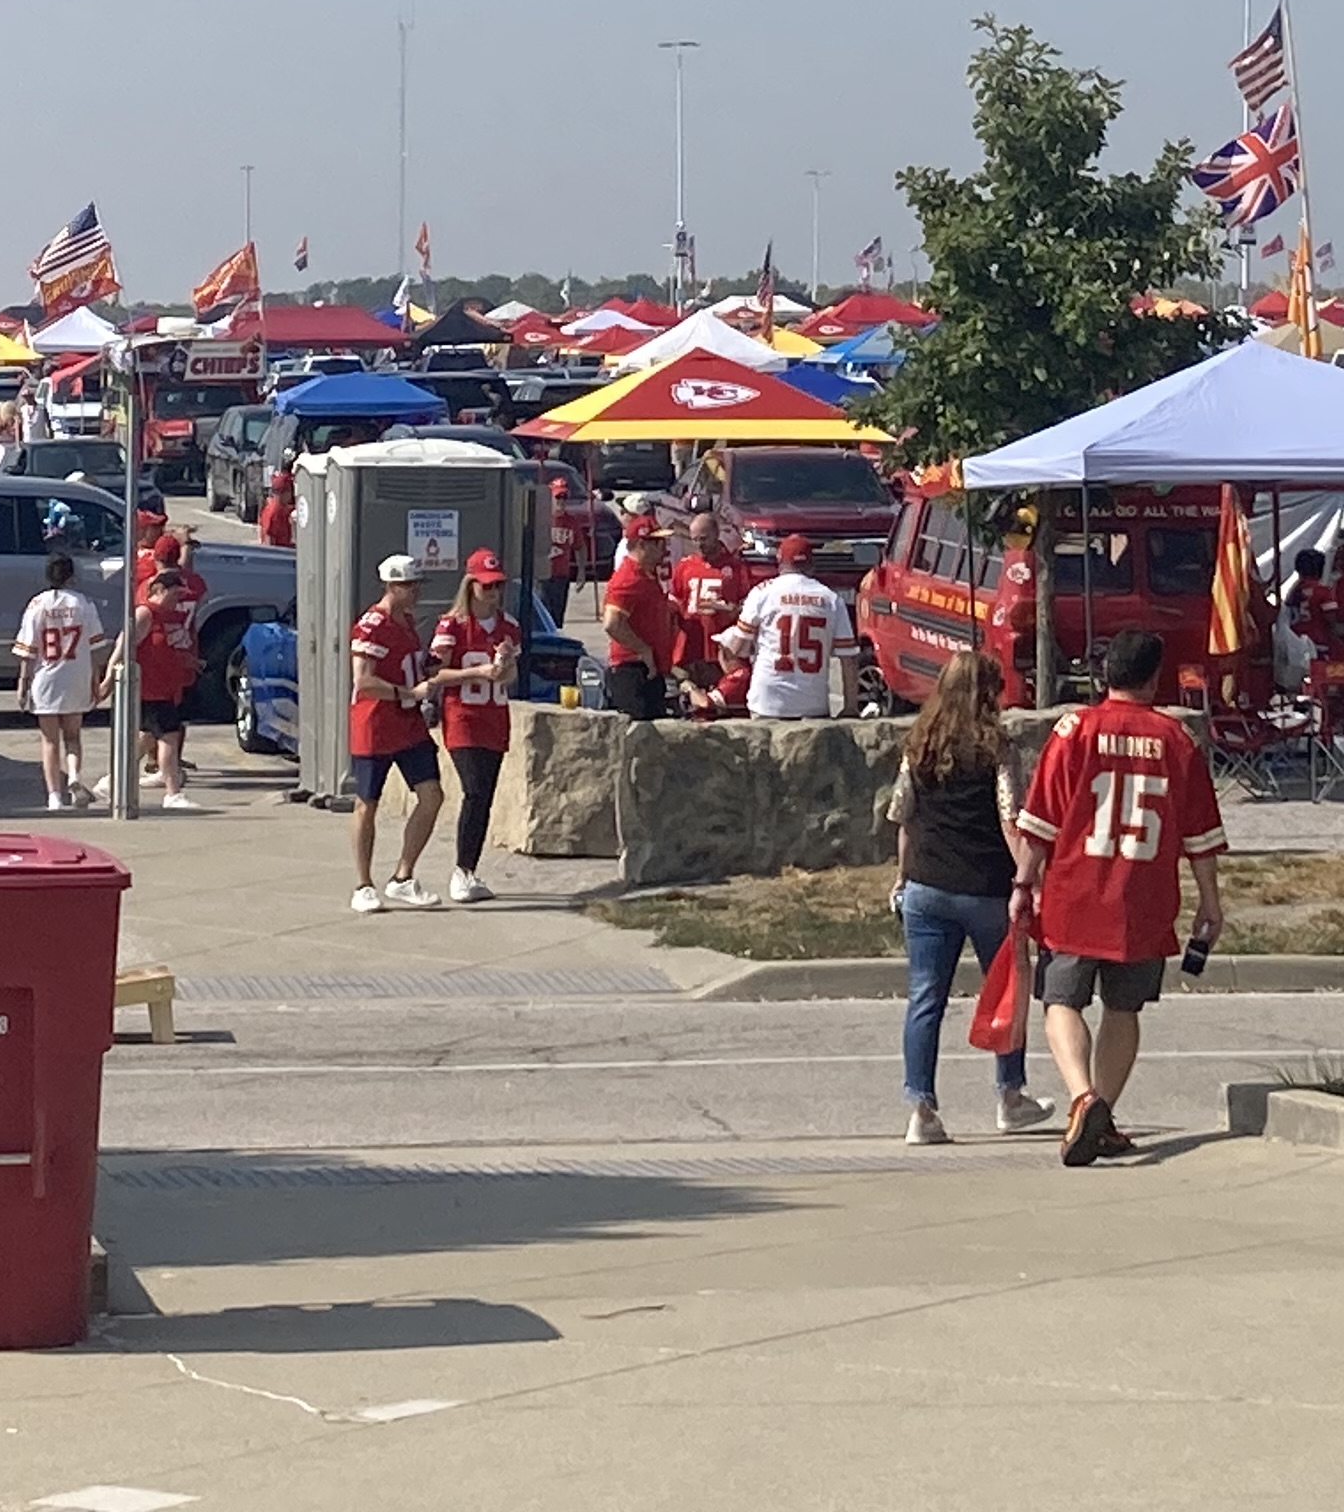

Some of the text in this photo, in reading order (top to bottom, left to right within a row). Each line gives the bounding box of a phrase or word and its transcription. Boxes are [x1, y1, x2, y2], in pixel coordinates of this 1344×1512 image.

[1143, 505, 1168, 517] ALL
[41, 625, 82, 661] 87
[775, 614, 827, 673] 15
[1098, 733, 1164, 760] MAHOMES
[1084, 770, 1169, 862] 15
